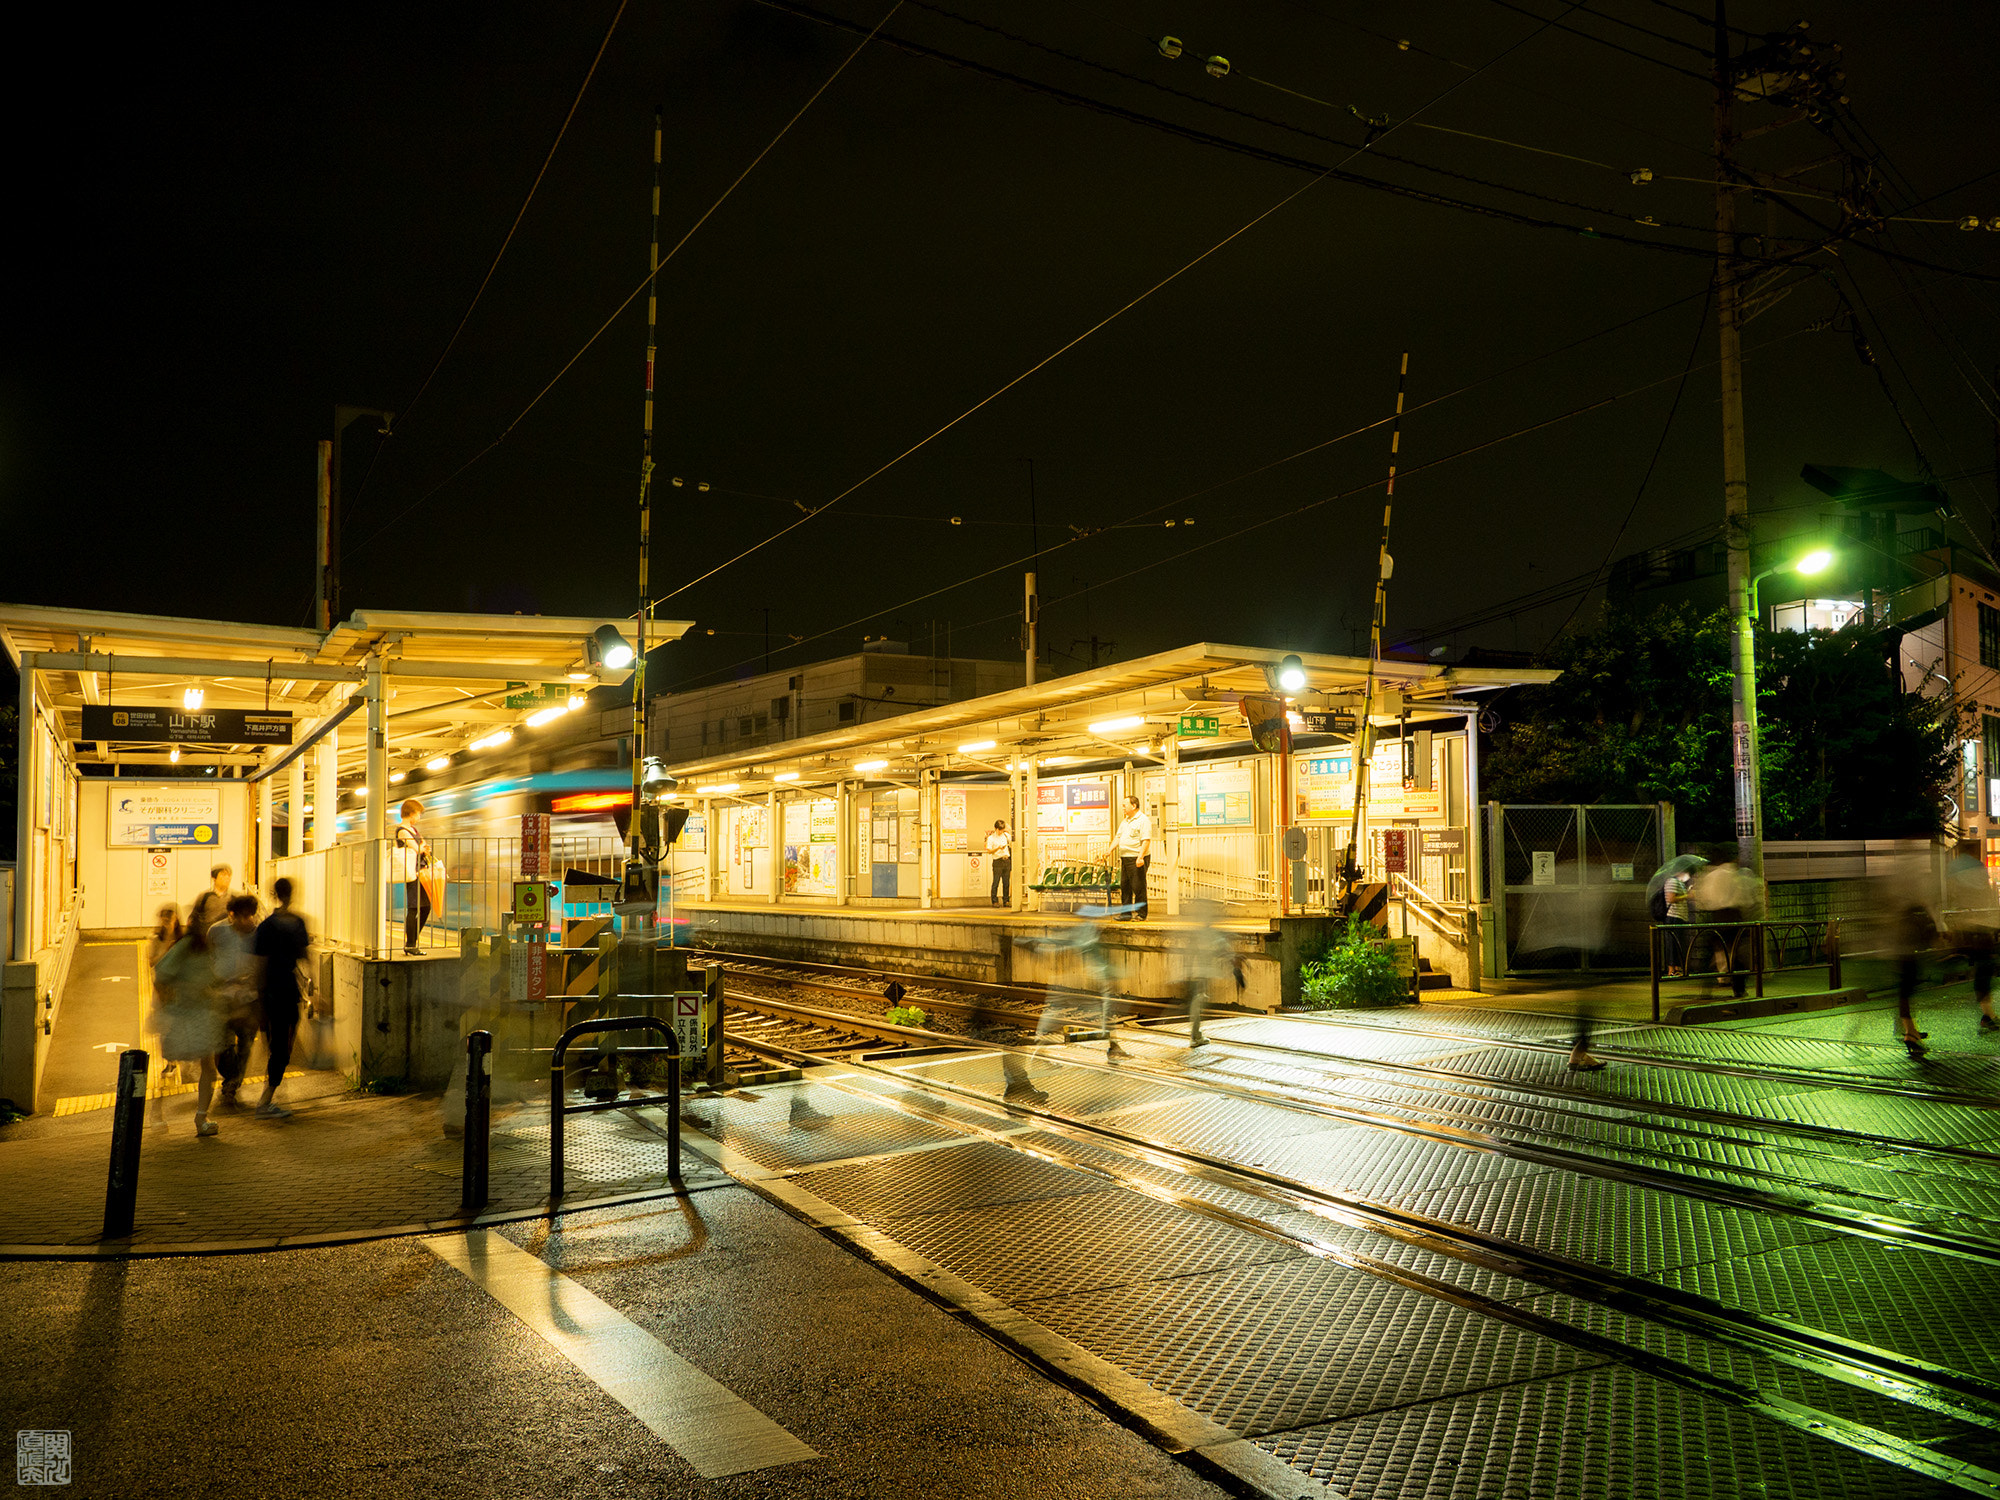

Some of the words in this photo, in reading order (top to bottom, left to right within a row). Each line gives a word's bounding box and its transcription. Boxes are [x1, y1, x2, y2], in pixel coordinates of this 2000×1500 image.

[169, 714, 215, 729] 山下駅
[1182, 718, 1217, 729] 乗車口
[1307, 716, 1326, 725] 山下駅
[245, 724, 286, 732] 下高井戸方面
[140, 806, 213, 814] そが眼科クリニック
[531, 946, 543, 996] 非常ボタン
[677, 1018, 686, 1053] 立入禁止
[689, 1018, 698, 1053] 係員以外
